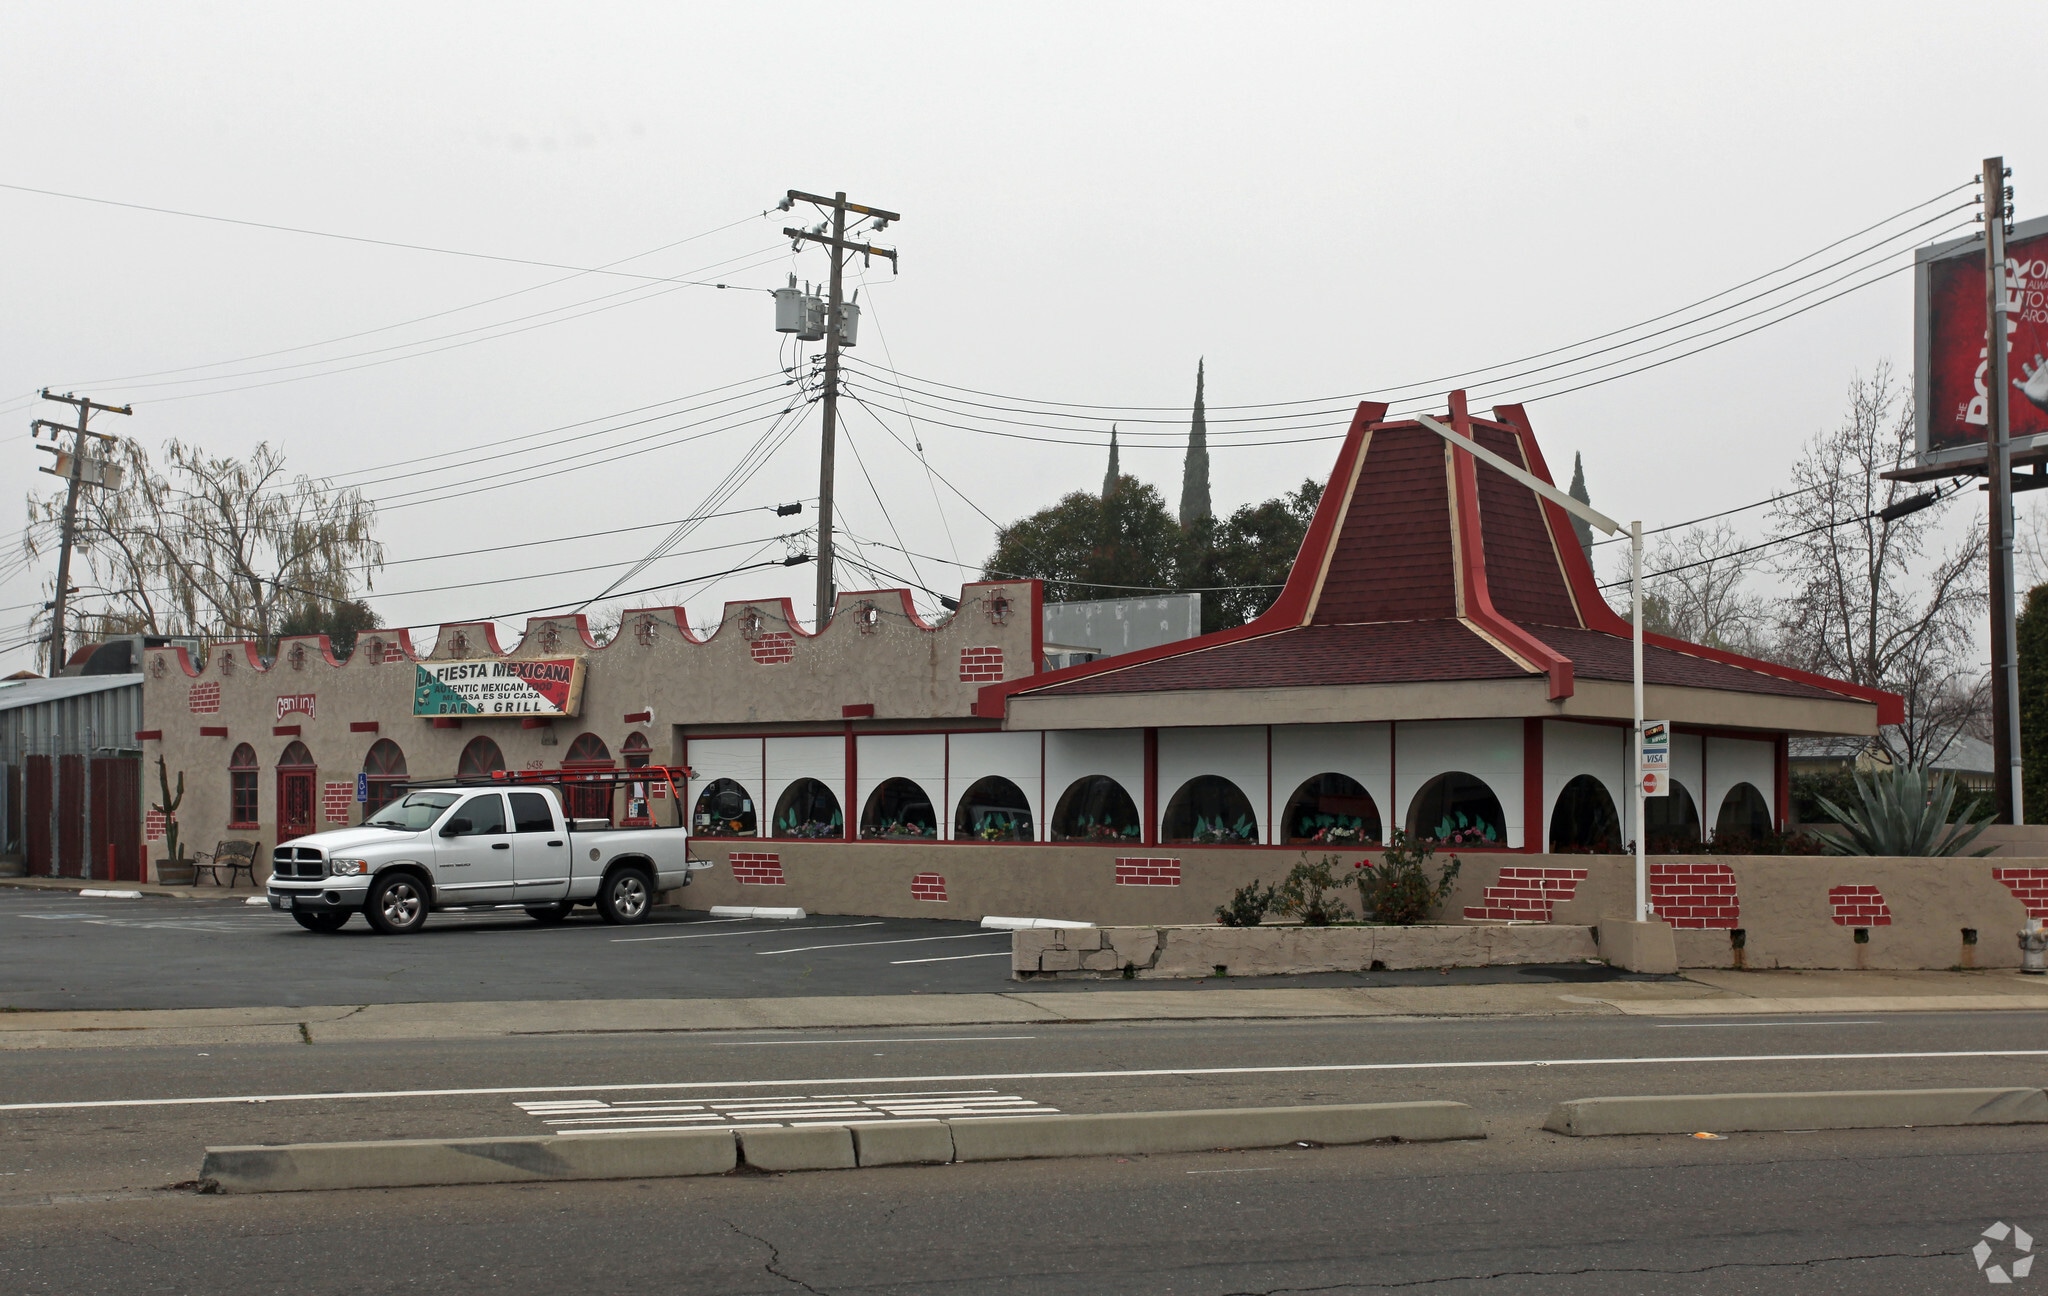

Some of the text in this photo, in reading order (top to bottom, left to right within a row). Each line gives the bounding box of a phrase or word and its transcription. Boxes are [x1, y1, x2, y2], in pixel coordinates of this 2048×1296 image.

[2026, 290, 2044, 308] TO
[1956, 403, 1968, 422] THE
[418, 662, 570, 687] LA FIESTA MEXICANA
[434, 681, 553, 694] AUTENTIC MEXICAN FOOD
[456, 693, 480, 701] CASA
[482, 692, 495, 700] ES
[497, 692, 511, 700] SU
[513, 691, 541, 699] CASA
[439, 701, 541, 714] BAR & GRILL
[526, 759, 544, 770] 6438
[1647, 755, 1663, 763] VISA
